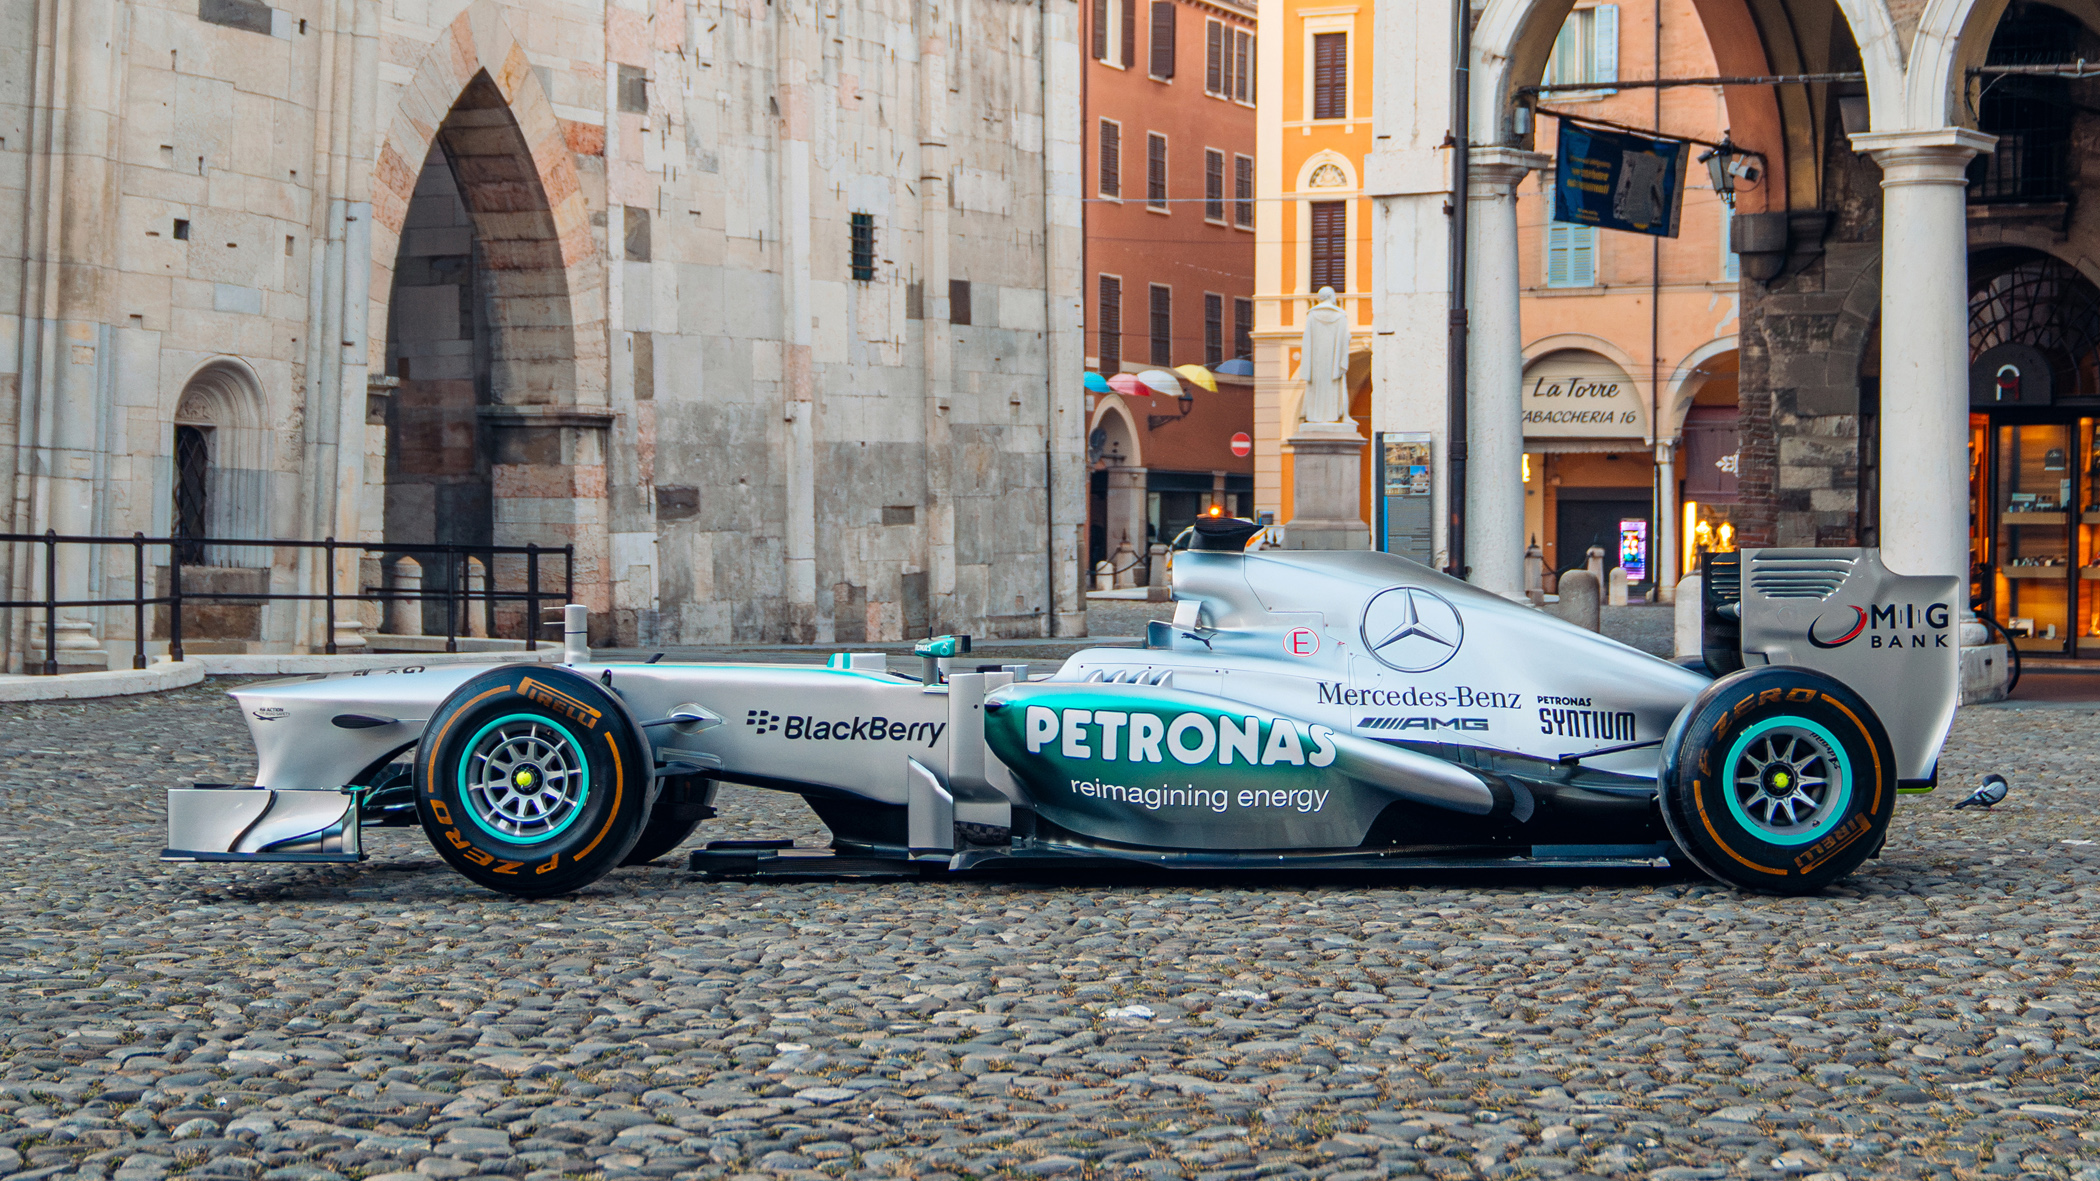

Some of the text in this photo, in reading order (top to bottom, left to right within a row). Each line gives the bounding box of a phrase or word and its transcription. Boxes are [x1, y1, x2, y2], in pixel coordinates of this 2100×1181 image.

[1533, 377, 1620, 398] La Torre
[1522, 410, 1636, 424] ABACCHERIA 16
[1293, 631, 1309, 654] E
[1870, 634, 1949, 648] BANK
[516, 676, 602, 729] PIRELLI
[1316, 682, 1522, 709] Mercedes-Benz
[1537, 695, 1592, 707] PETRONAS
[1539, 708, 1636, 741] SYNTIUM
[1712, 687, 1817, 742] ZERO
[784, 715, 946, 748] BlackBerry
[1026, 704, 1338, 768] PETRONAS
[1070, 778, 1330, 813] reimagining energy
[430, 799, 560, 875] P ZERO
[1794, 812, 1872, 875] PIRELLI
